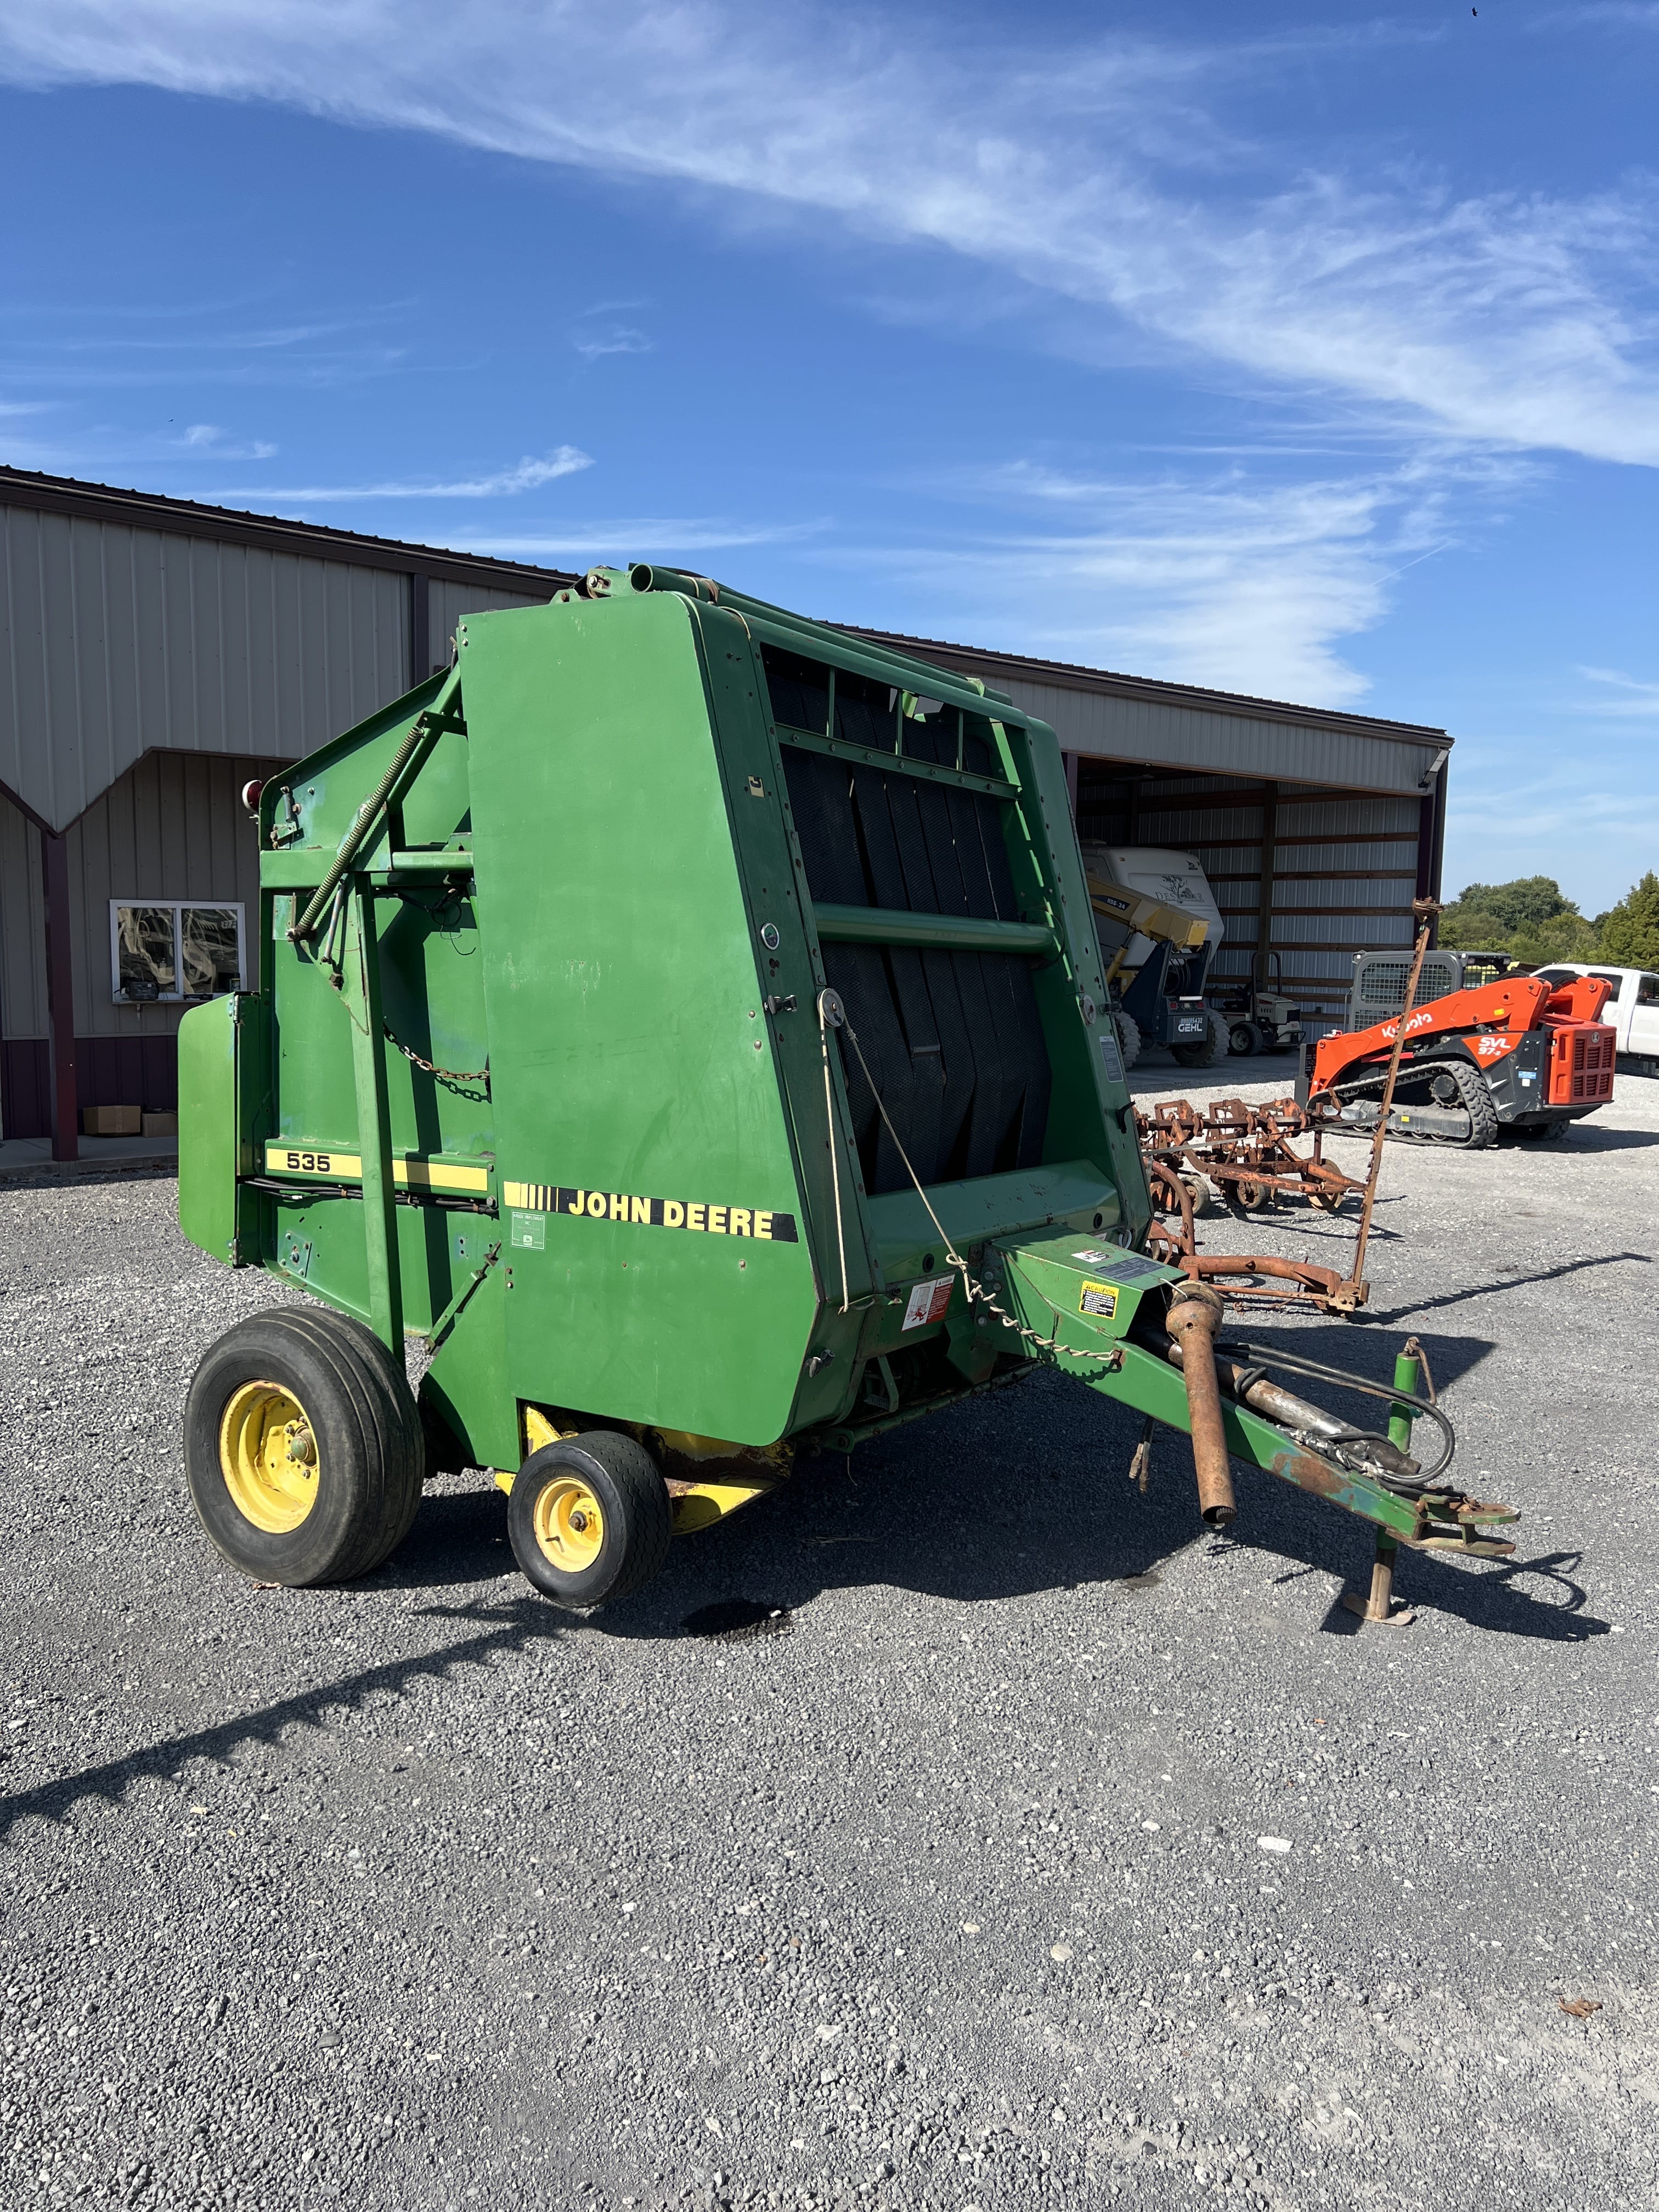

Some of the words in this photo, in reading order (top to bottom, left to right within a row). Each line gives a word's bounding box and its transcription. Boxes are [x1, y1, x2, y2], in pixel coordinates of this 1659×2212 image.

[1178, 1023, 1203, 1032] GEHL
[1479, 1037, 1511, 1048] SVL
[1478, 1047, 1502, 1056] 97-2
[287, 1152, 330, 1172] 535
[568, 1189, 651, 1224] JOHN
[663, 1200, 773, 1239] DEERE
[1091, 1285, 1115, 1295] CAUTION
